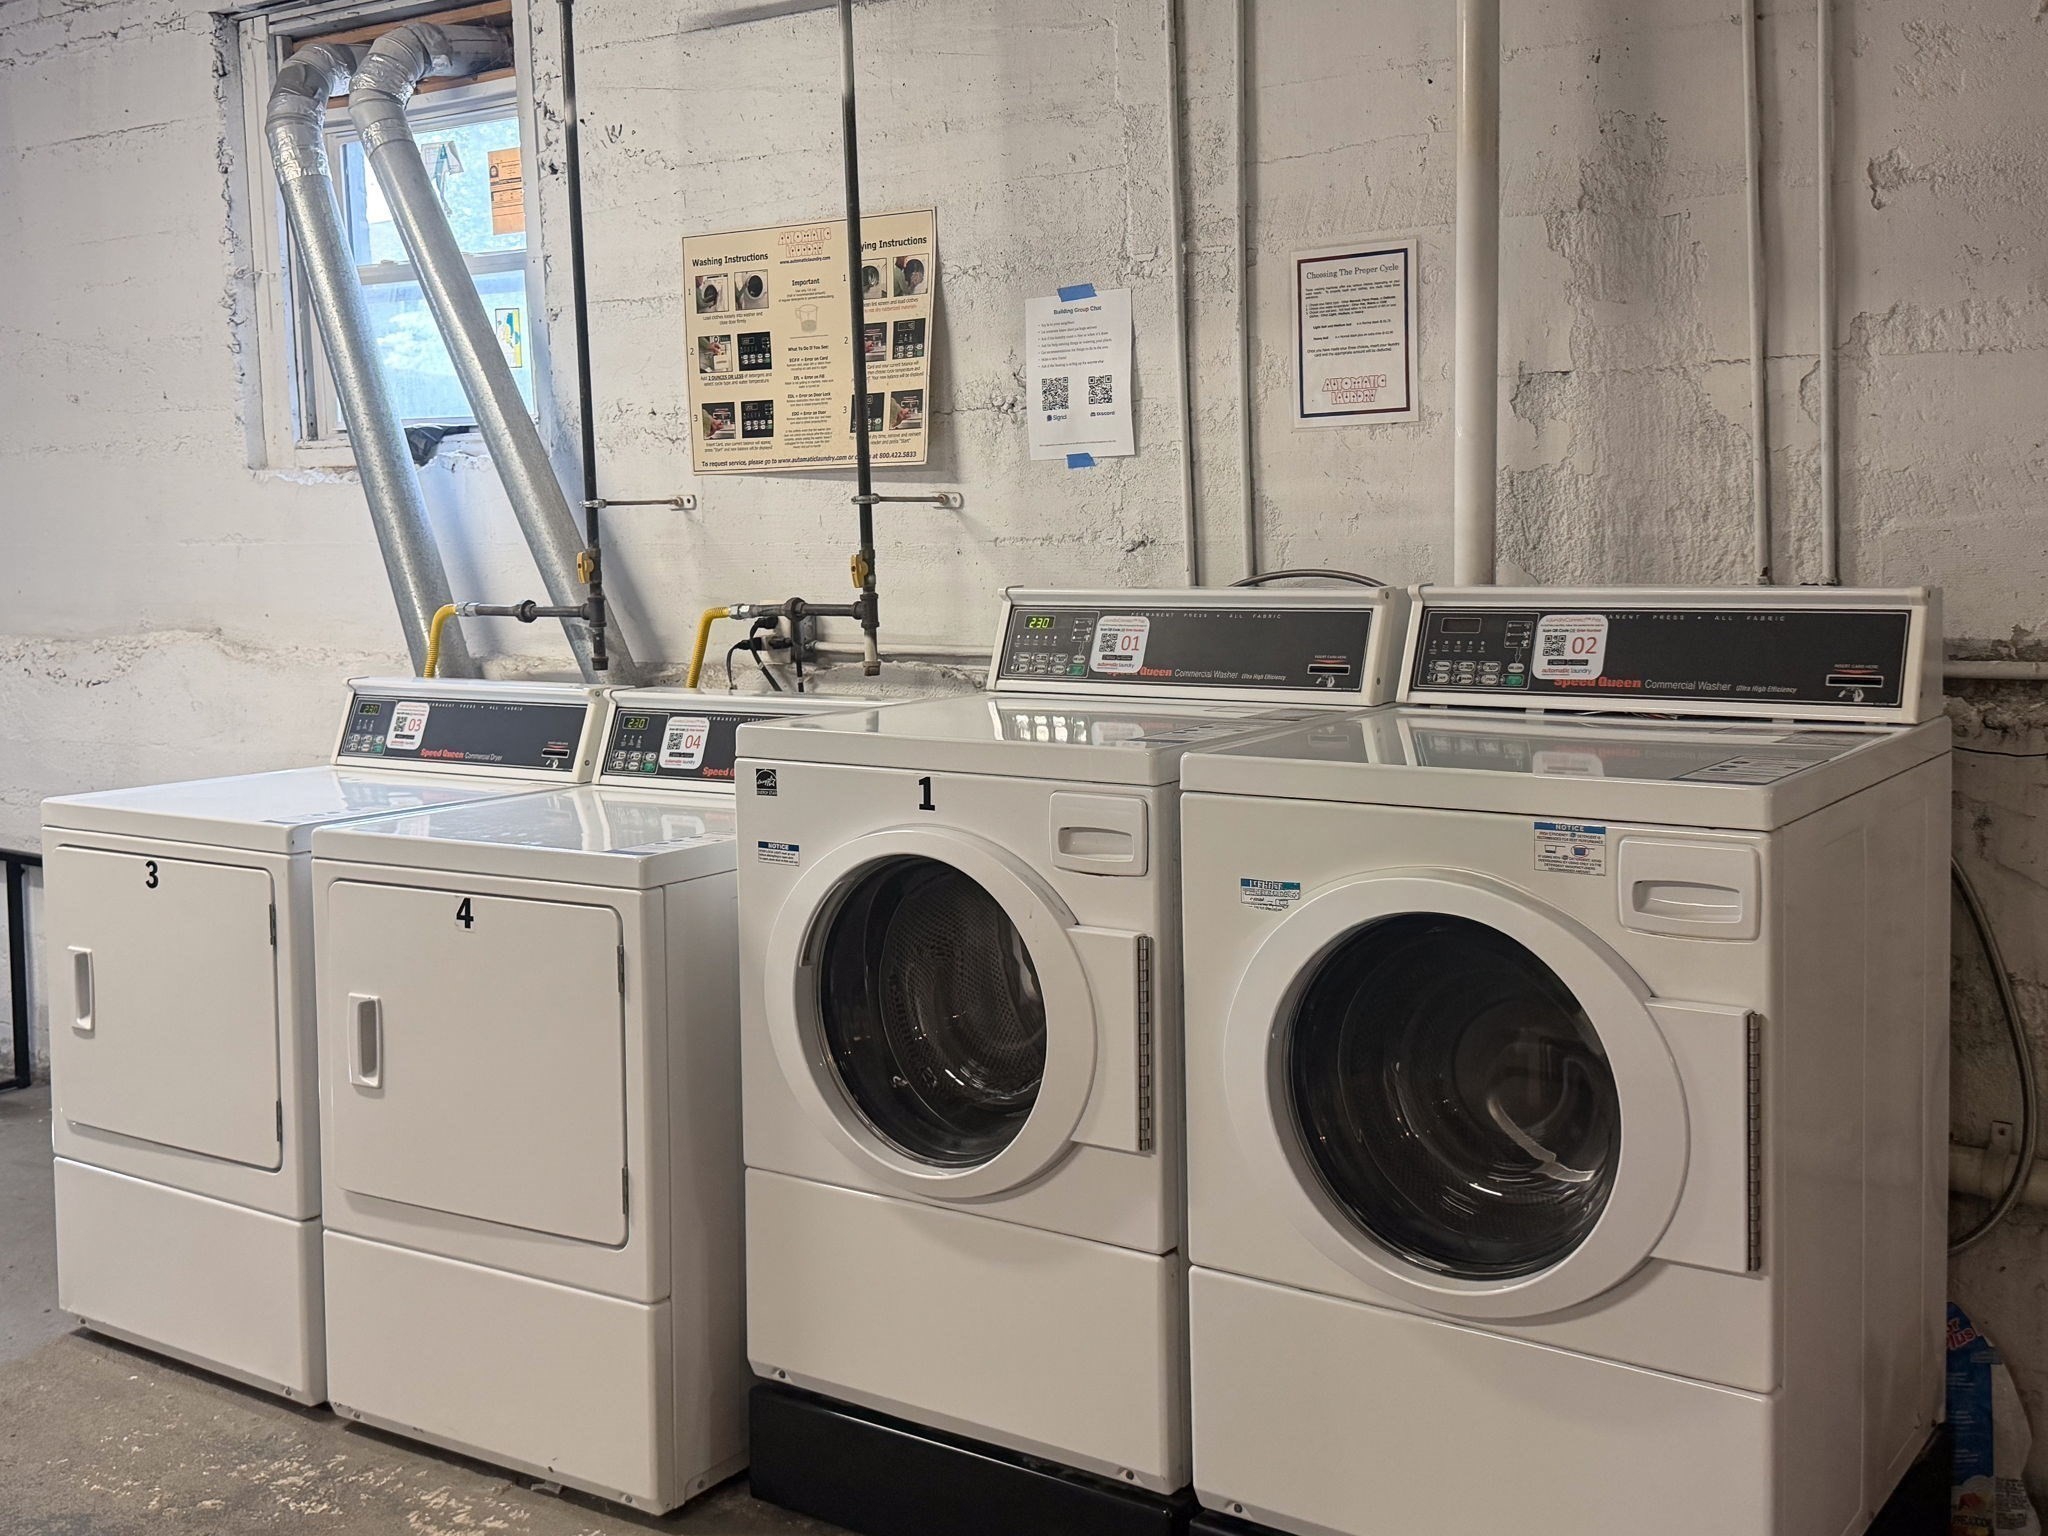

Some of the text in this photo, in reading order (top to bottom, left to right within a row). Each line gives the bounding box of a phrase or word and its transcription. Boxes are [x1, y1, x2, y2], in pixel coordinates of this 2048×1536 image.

[861, 237, 927, 252] ying Instructions
[692, 252, 768, 267] Washing Instructions
[780, 256, 831, 265] www.automaticlaundry.com
[1306, 271, 1338, 279] Choosing
[1354, 266, 1378, 275] Proper
[1380, 263, 1399, 272] Cycle
[792, 278, 820, 286] Important
[690, 347, 694, 355] 2
[1322, 374, 1386, 392] AUTOMATIC
[1331, 388, 1377, 405] LAUNDRY
[843, 406, 847, 414] 3
[1029, 617, 1050, 628] 230
[1121, 635, 1139, 651] 01
[1572, 637, 1597, 654] 02
[1140, 666, 1172, 677] Queen
[1174, 668, 1212, 678] Commercial
[1214, 670, 1238, 679] Washer
[1554, 679, 1596, 688] Speed
[1598, 677, 1641, 688] Queen
[1645, 680, 1696, 690] Commercial
[1698, 681, 1732, 691] Washer
[1767, 686, 1798, 694] Efficiency
[408, 719, 422, 732] 03
[628, 719, 644, 728] 230
[685, 734, 701, 748] 04
[421, 748, 442, 758] Speed
[443, 750, 464, 758] Queen
[465, 752, 490, 760] Commercial
[702, 766, 728, 776] Speed
[918, 777, 935, 811] 1
[146, 860, 159, 889] 3
[456, 897, 474, 929] 4
